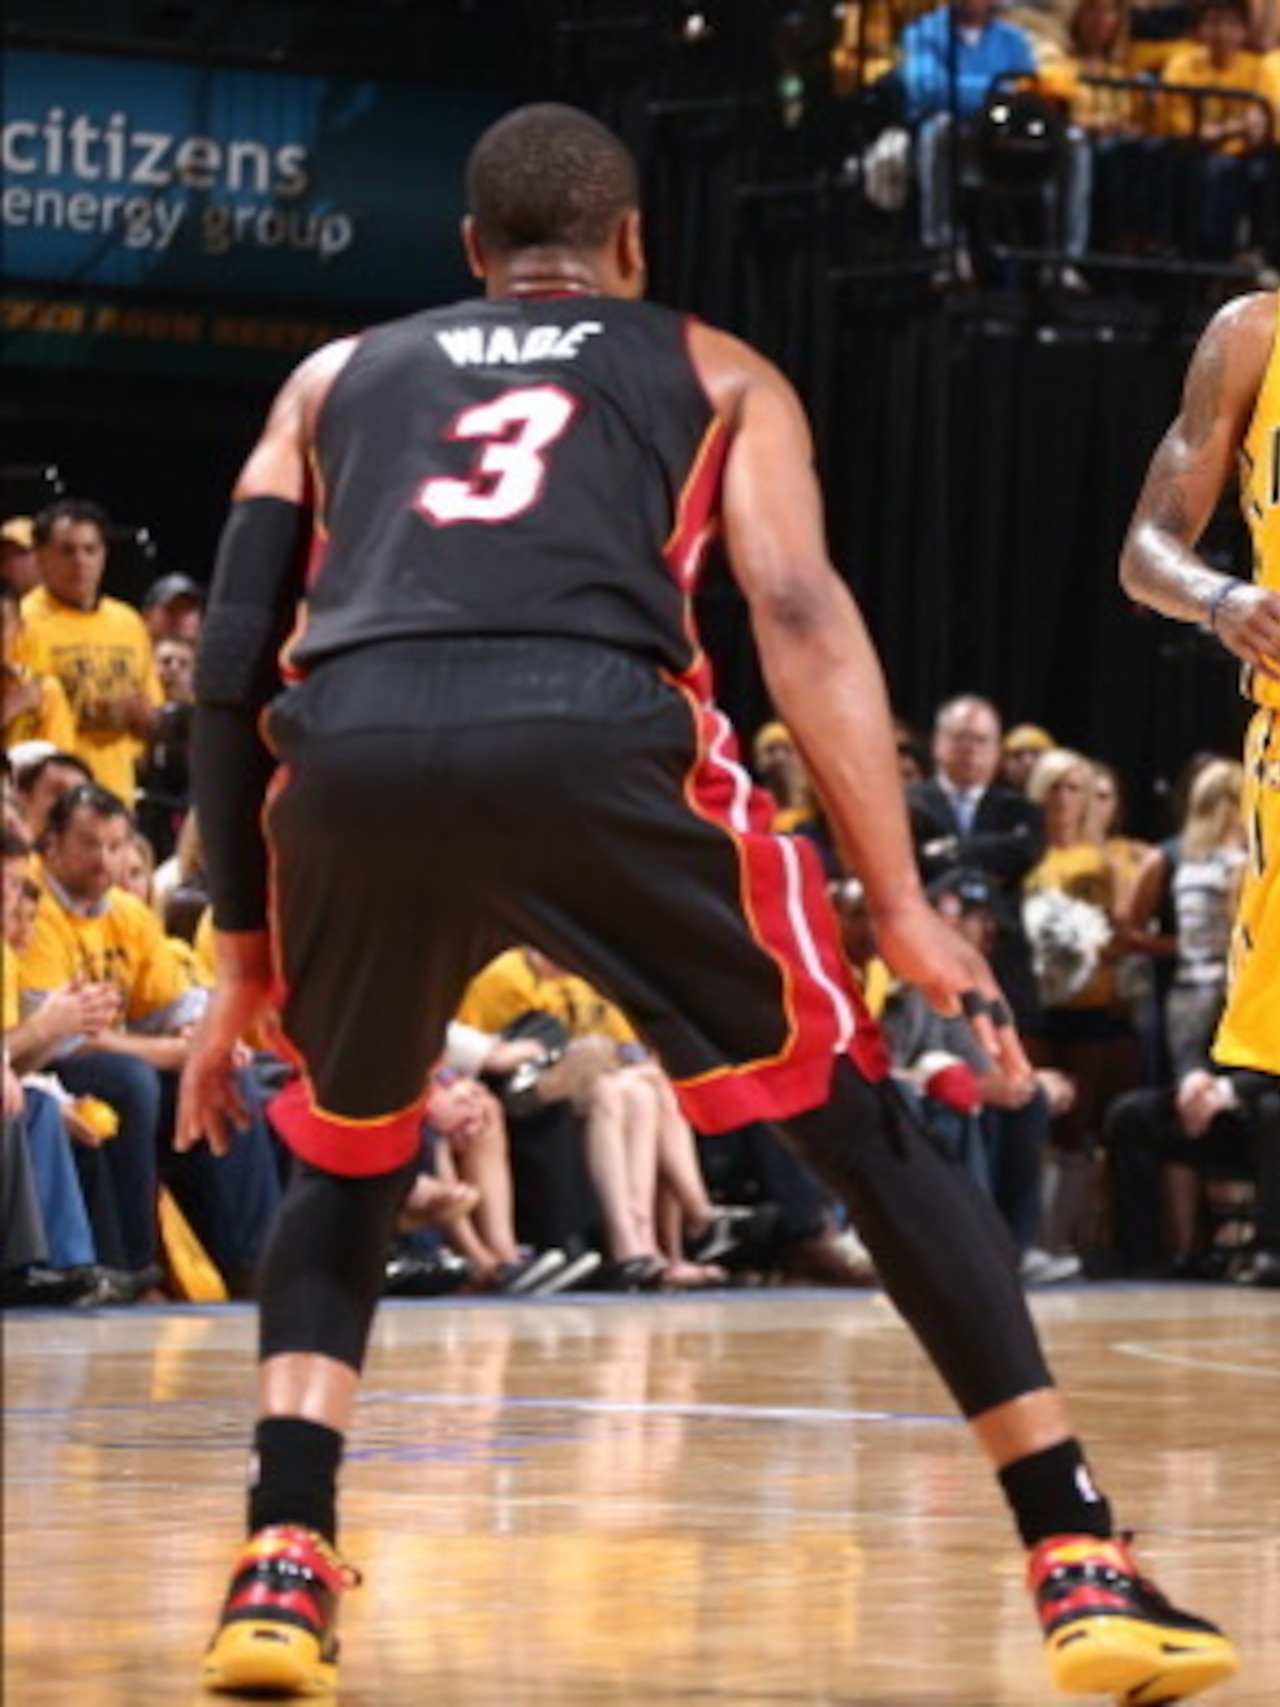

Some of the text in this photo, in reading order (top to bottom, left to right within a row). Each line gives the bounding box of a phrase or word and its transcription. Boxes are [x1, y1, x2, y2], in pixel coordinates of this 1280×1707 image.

[1, 106, 308, 196] citizens
[2, 186, 354, 262] energy group
[435, 320, 604, 367] WADE
[412, 382, 584, 529] 3
